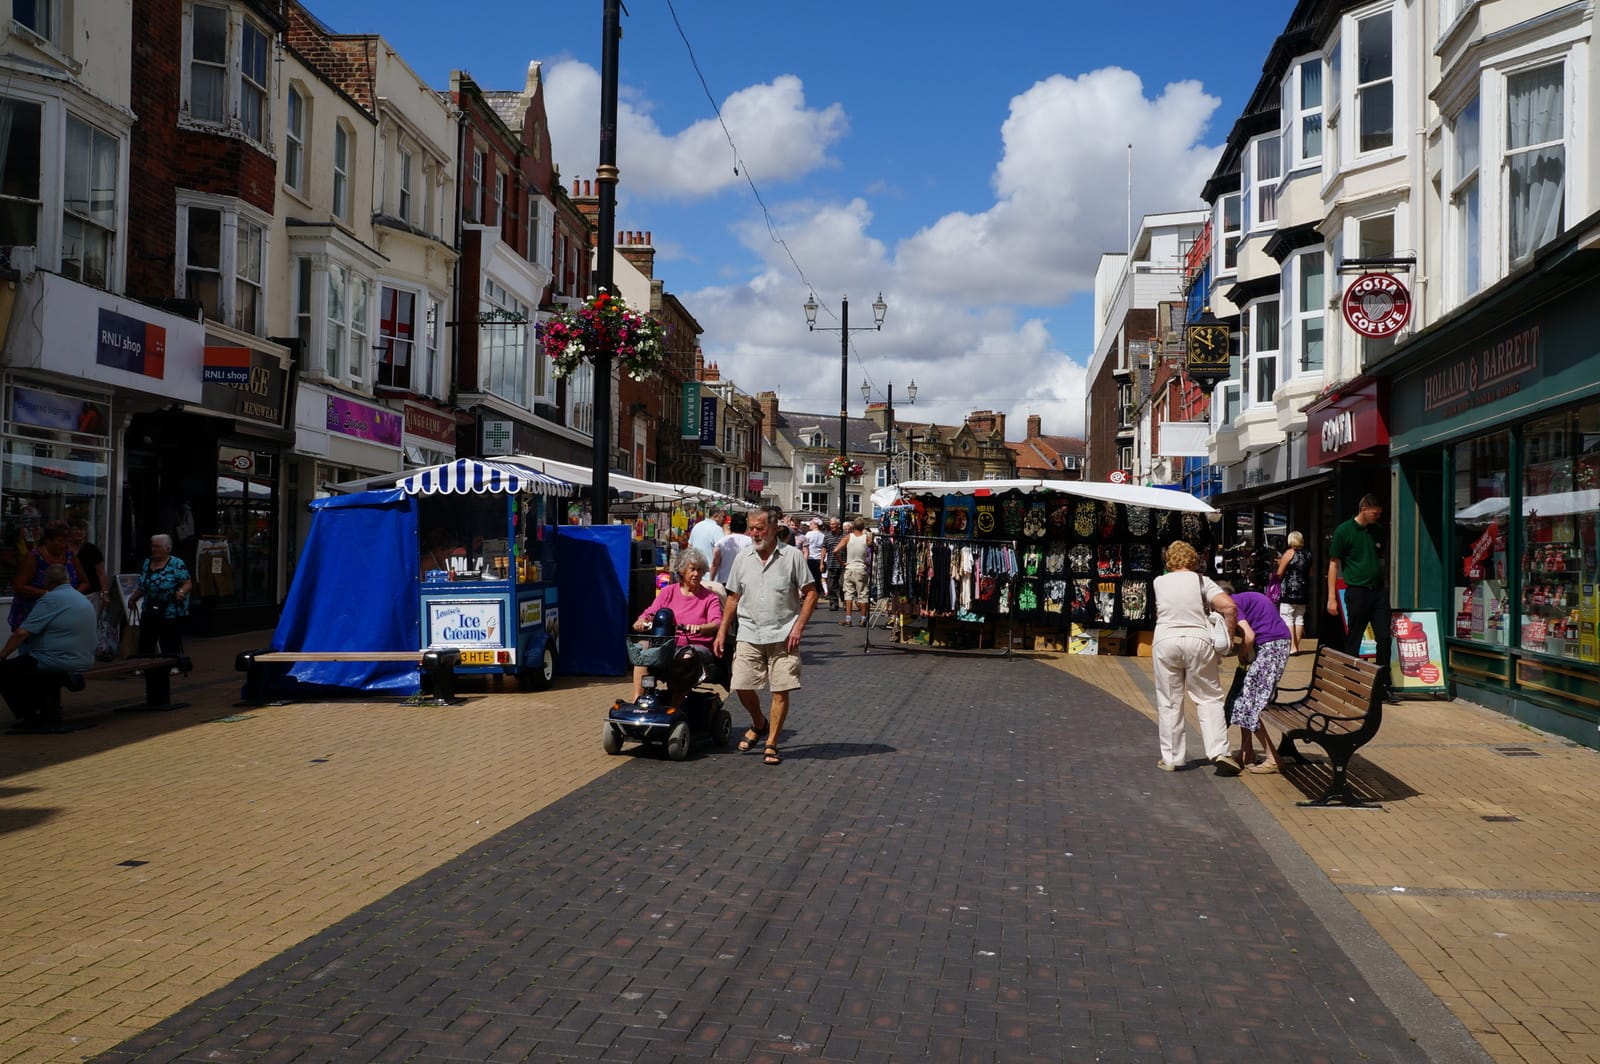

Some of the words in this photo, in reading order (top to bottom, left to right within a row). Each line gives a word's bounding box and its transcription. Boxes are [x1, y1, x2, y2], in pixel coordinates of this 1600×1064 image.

[1354, 278, 1398, 296] COSTA
[1352, 311, 1403, 333] COFFEE
[101, 329, 122, 348] RNLI
[122, 336, 142, 357] shop
[204, 370, 225, 380] RNLI
[226, 371, 248, 382] shop
[1424, 361, 1466, 412] HOLLAND
[1469, 356, 1478, 392] &
[1483, 325, 1540, 381] BARRETT
[687, 386, 696, 431] LIBRARY
[1321, 410, 1353, 453] COSTA
[459, 614, 480, 628] Ice
[443, 627, 487, 641] Creams
[1399, 641, 1427, 652] WHEY
[470, 651, 489, 661] HTE
